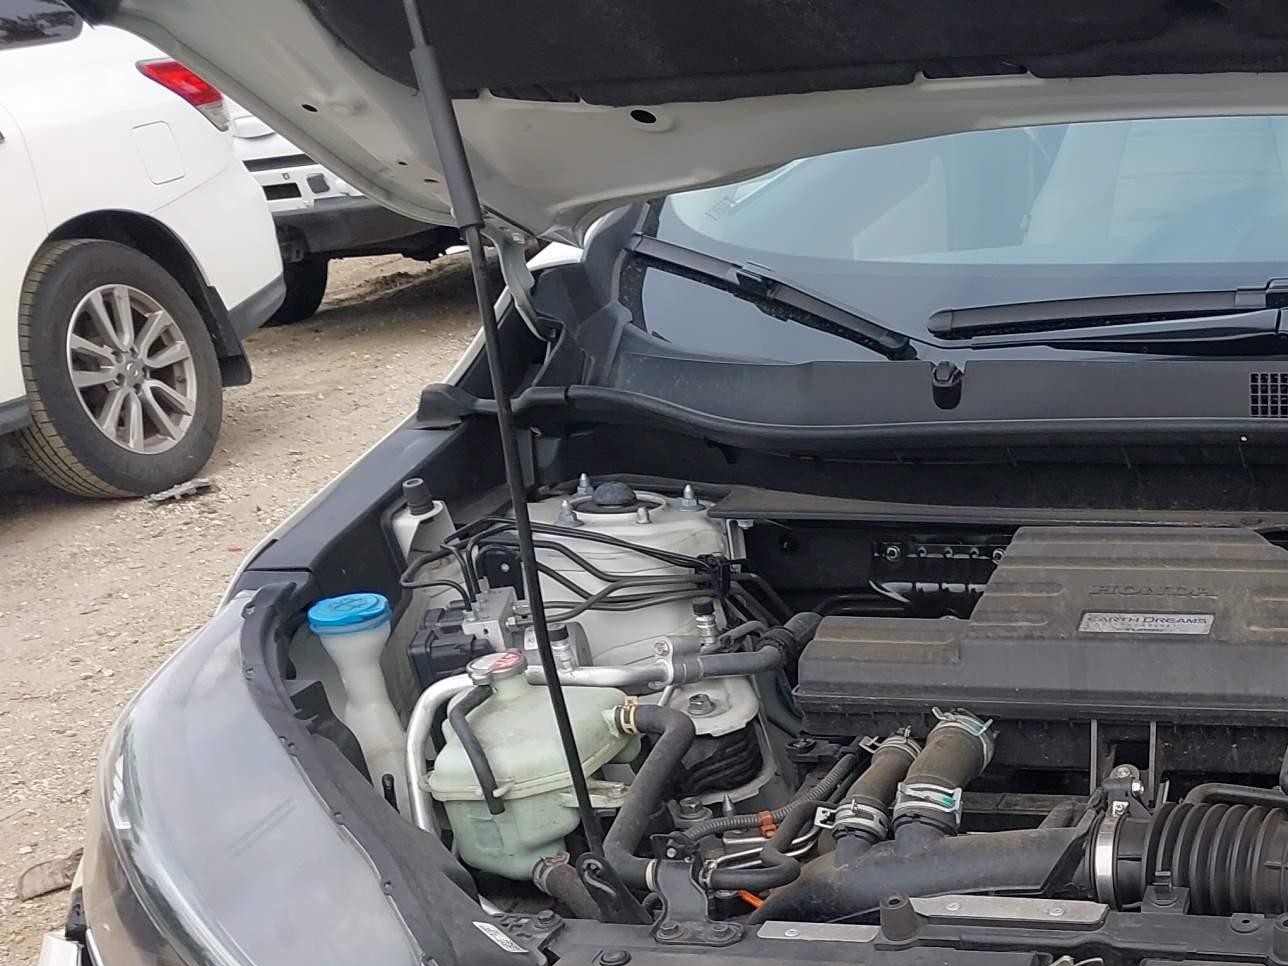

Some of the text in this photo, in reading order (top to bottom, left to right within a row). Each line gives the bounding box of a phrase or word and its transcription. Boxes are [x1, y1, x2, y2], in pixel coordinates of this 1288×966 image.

[1088, 584, 1219, 599] HONDA
[1087, 616, 1208, 624] EARTH DREAMS
